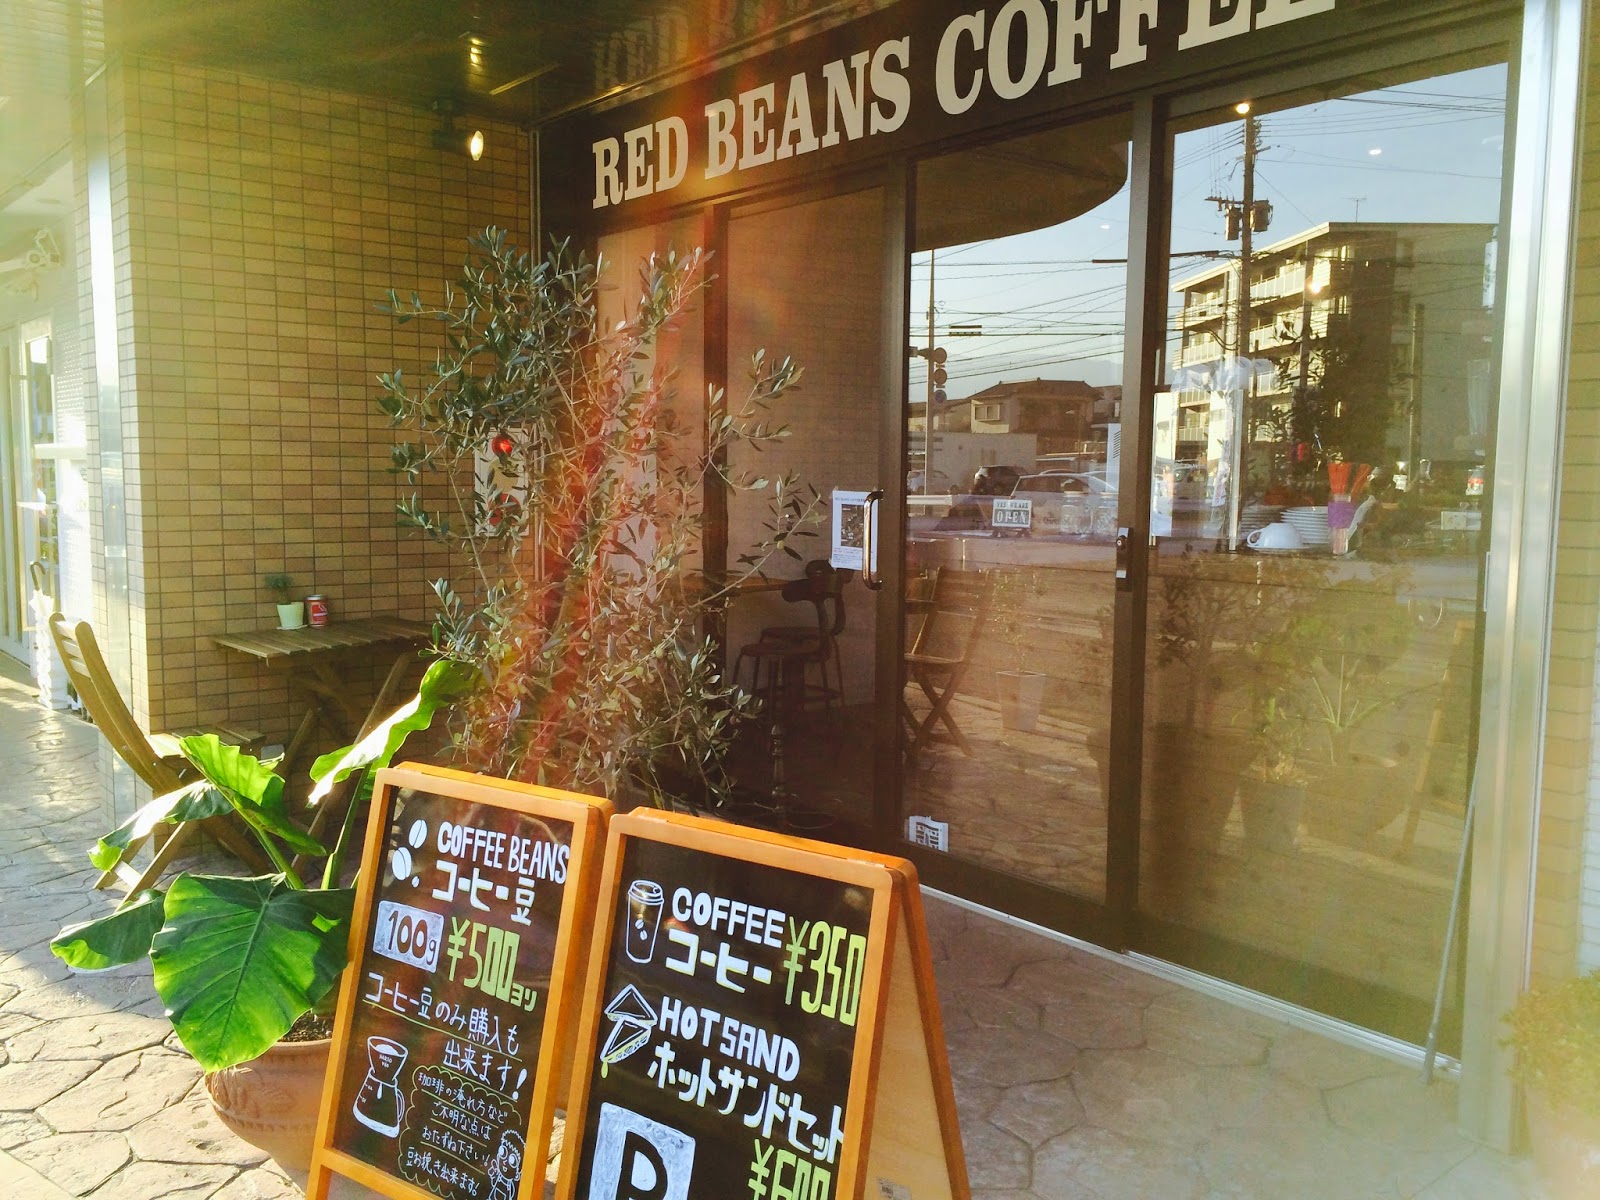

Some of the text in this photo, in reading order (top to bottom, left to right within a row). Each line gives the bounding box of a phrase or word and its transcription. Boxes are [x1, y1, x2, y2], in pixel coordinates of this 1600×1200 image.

[593, 116, 688, 209] RED
[704, 36, 911, 180] BEANS
[935, 0, 1335, 115] COFF
[996, 511, 1028, 524] OPEN
[437, 821, 570, 884] COFFEE BEANS
[432, 860, 536, 926] コーヒー豆
[672, 886, 786, 949] COFFEE
[388, 910, 438, 966] 100g
[665, 928, 772, 993] コーヒー
[783, 916, 867, 1027] ¥350
[365, 971, 520, 1055] コーヒー豆のみ購入も
[659, 995, 800, 1082] HOT SAND
[431, 1101, 491, 1140] ご不明な点は
[647, 1041, 844, 1164] ホットサンドセット
